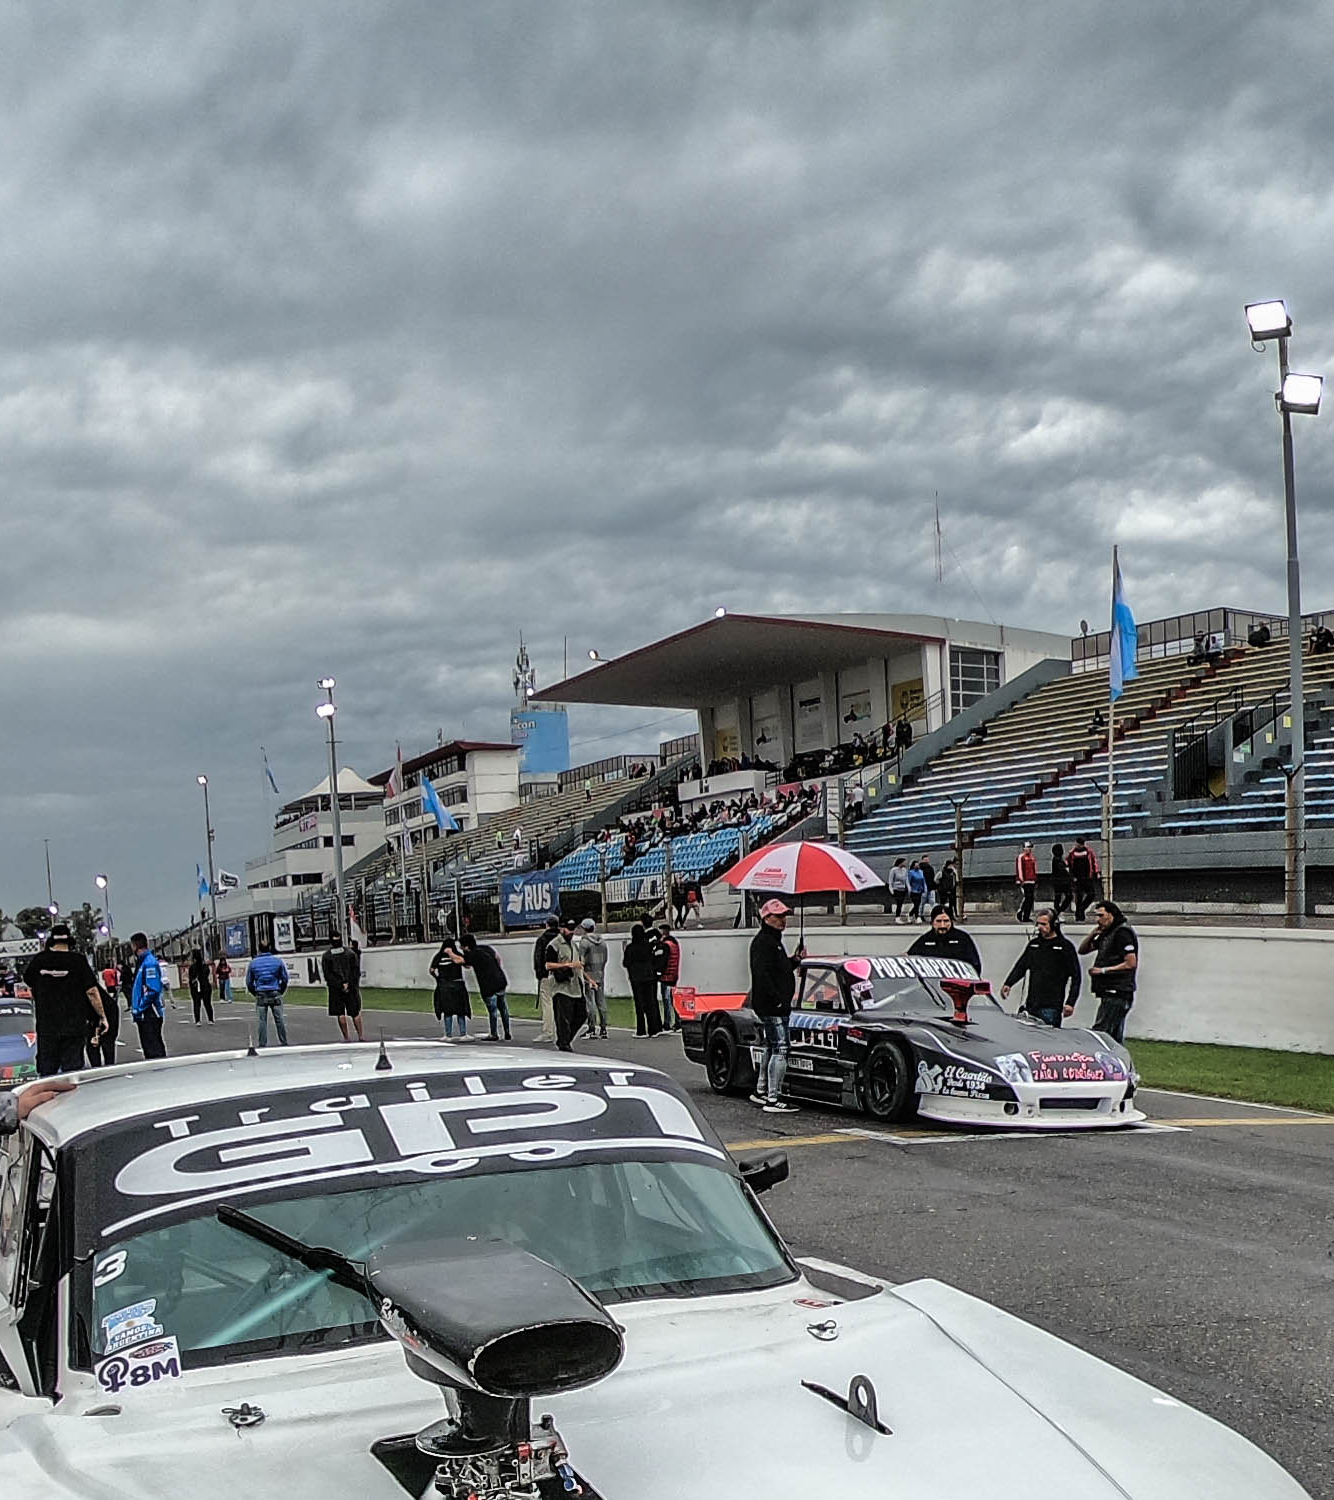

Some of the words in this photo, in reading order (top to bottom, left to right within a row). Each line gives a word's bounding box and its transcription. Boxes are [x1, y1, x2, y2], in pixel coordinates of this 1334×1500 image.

[524, 882, 552, 912] RUS
[869, 957, 906, 979] POR
[153, 1072, 635, 1138] Trailer
[115, 1085, 705, 1195] GP1
[94, 1249, 128, 1287] 3
[129, 1357, 180, 1387] 8M
